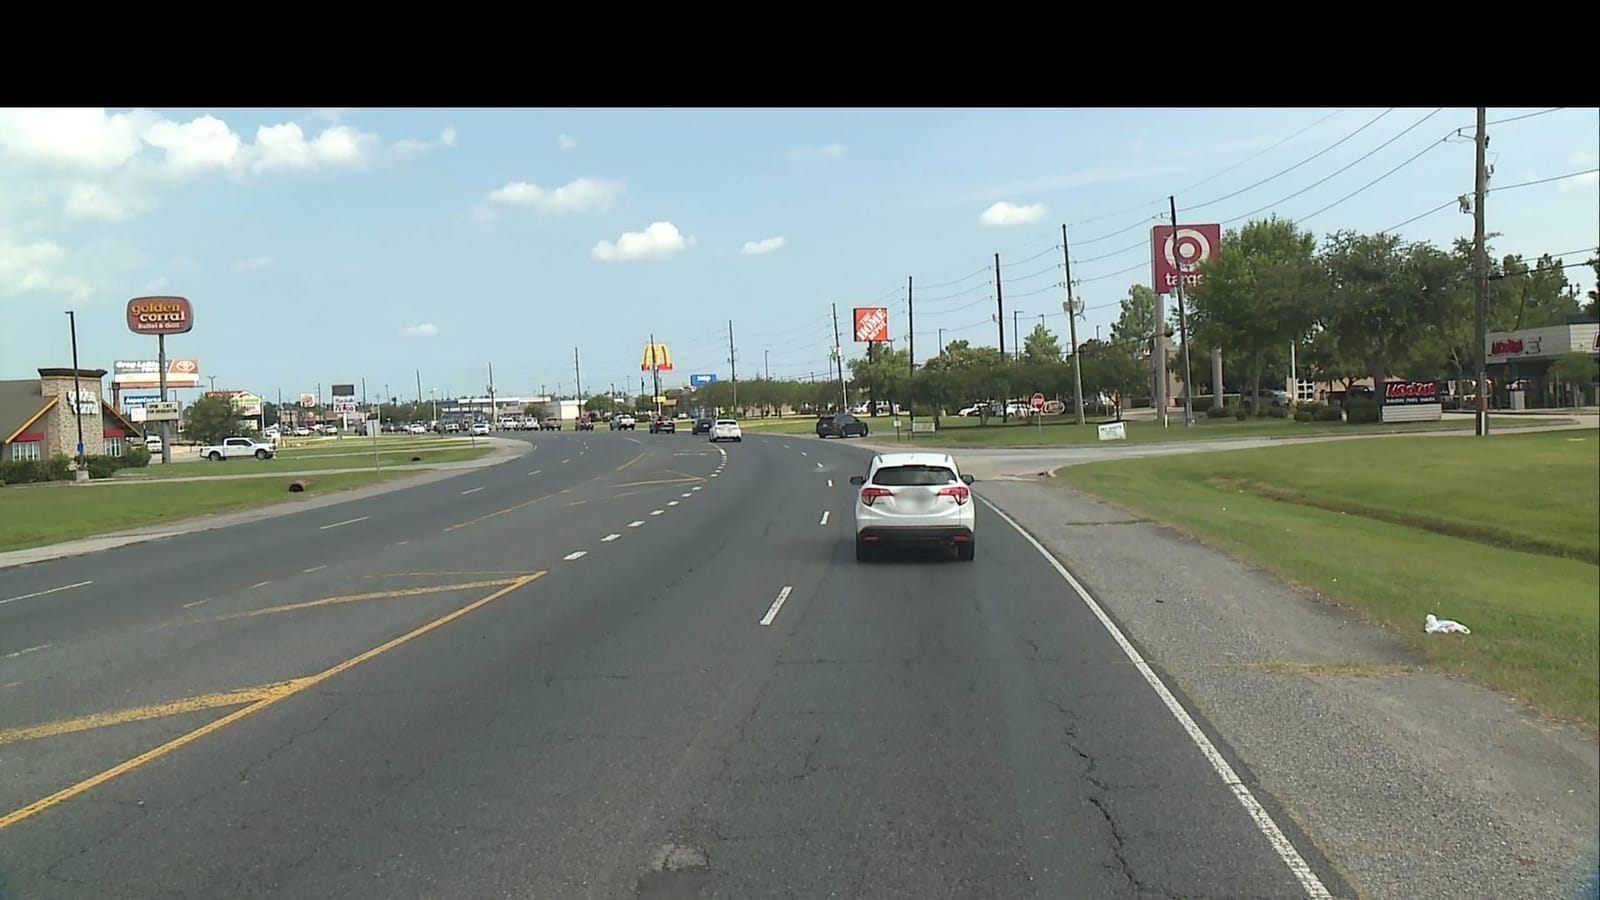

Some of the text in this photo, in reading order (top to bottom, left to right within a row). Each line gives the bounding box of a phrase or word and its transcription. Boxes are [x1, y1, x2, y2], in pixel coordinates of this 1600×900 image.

[131, 303, 181, 315] golden
[139, 311, 186, 322] corral
[856, 308, 887, 340] HOME
[868, 319, 887, 341] DEPOT
